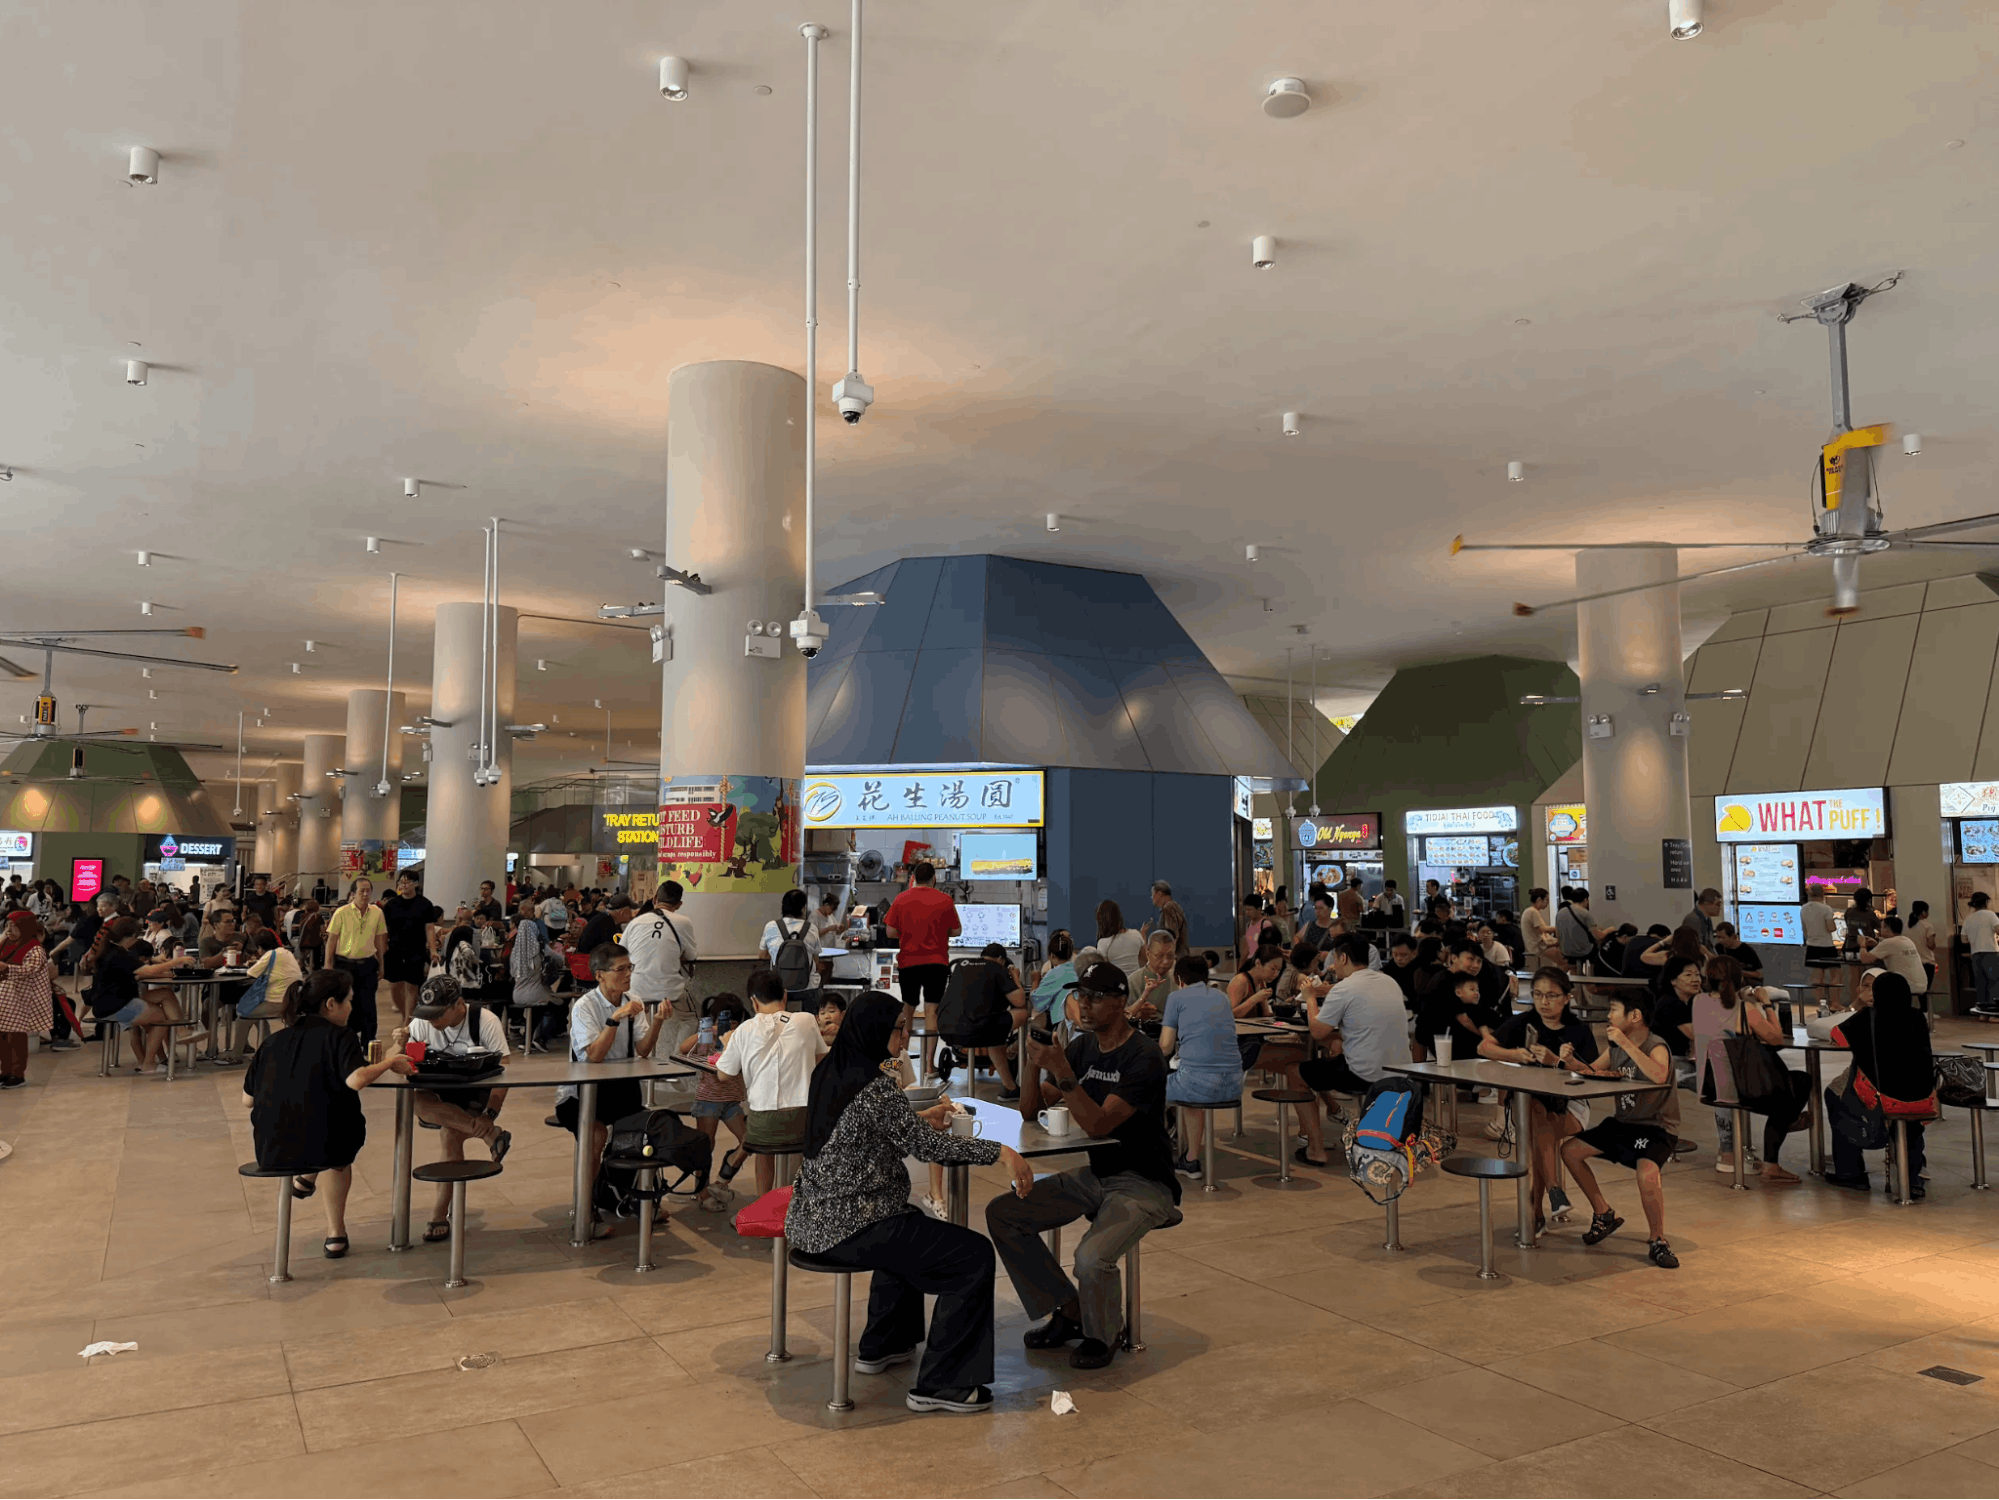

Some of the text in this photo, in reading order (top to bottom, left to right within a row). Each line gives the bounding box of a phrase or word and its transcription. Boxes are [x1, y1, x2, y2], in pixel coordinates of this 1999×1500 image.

[857, 779, 1012, 811] 花生湯圓
[1829, 799, 1843, 808] THE
[604, 813, 660, 827] TRAY RETU
[668, 810, 701, 822] FEED
[887, 813, 899, 821] AH
[934, 813, 965, 821] PEANUT
[966, 813, 987, 821] SOUP
[1450, 812, 1470, 821] THAI
[1472, 810, 1495, 820] FOOD
[1758, 800, 1827, 832] WHAT
[1829, 808, 1870, 830] PUFF
[616, 830, 659, 844] STATION
[1317, 824, 1361, 843] Old Nyonya
[180, 843, 223, 855] DESSERT
[677, 850, 717, 859] responsibly
